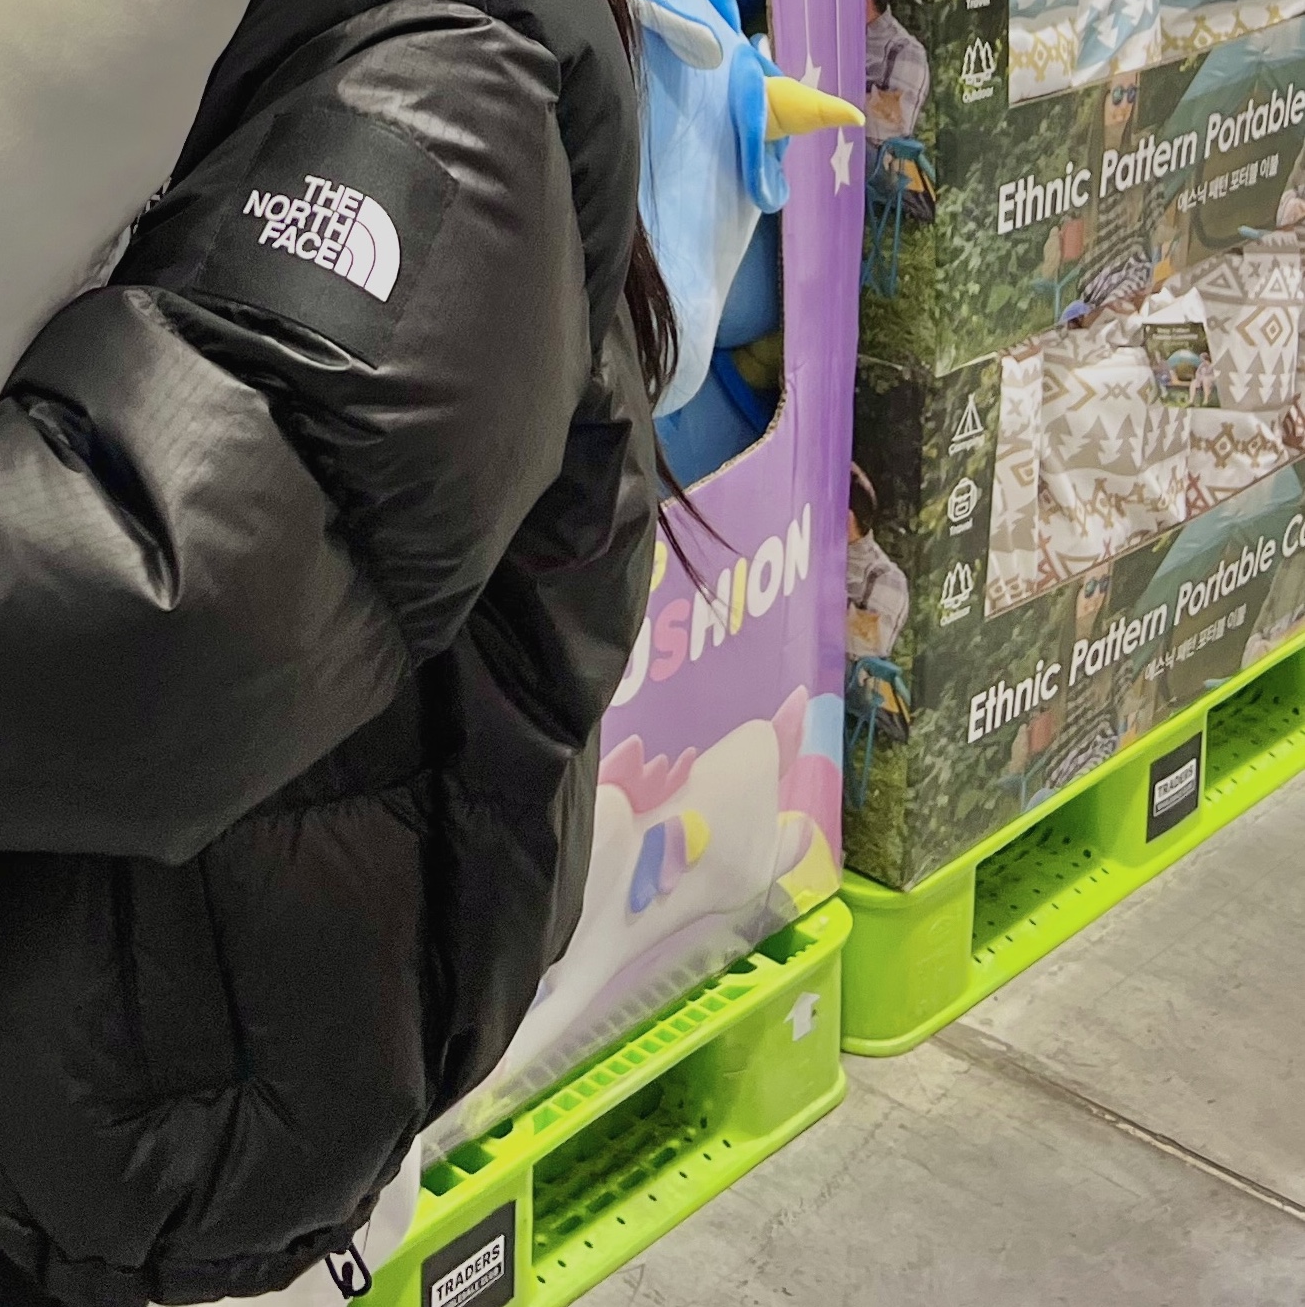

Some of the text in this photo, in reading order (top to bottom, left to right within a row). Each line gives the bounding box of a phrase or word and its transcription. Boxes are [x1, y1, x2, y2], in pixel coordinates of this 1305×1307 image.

[997, 83, 1305, 235] Ethnic Pattern Portable
[243, 189, 355, 246] NORTH
[304, 175, 364, 219] THE
[1177, 180, 1209, 213] 에스닉
[258, 221, 343, 271] FACE
[968, 660, 1061, 744] Ethnic
[1068, 603, 1168, 687] Pattern
[1173, 535, 1276, 626] Portable
[436, 1244, 500, 1301] TRADERS
